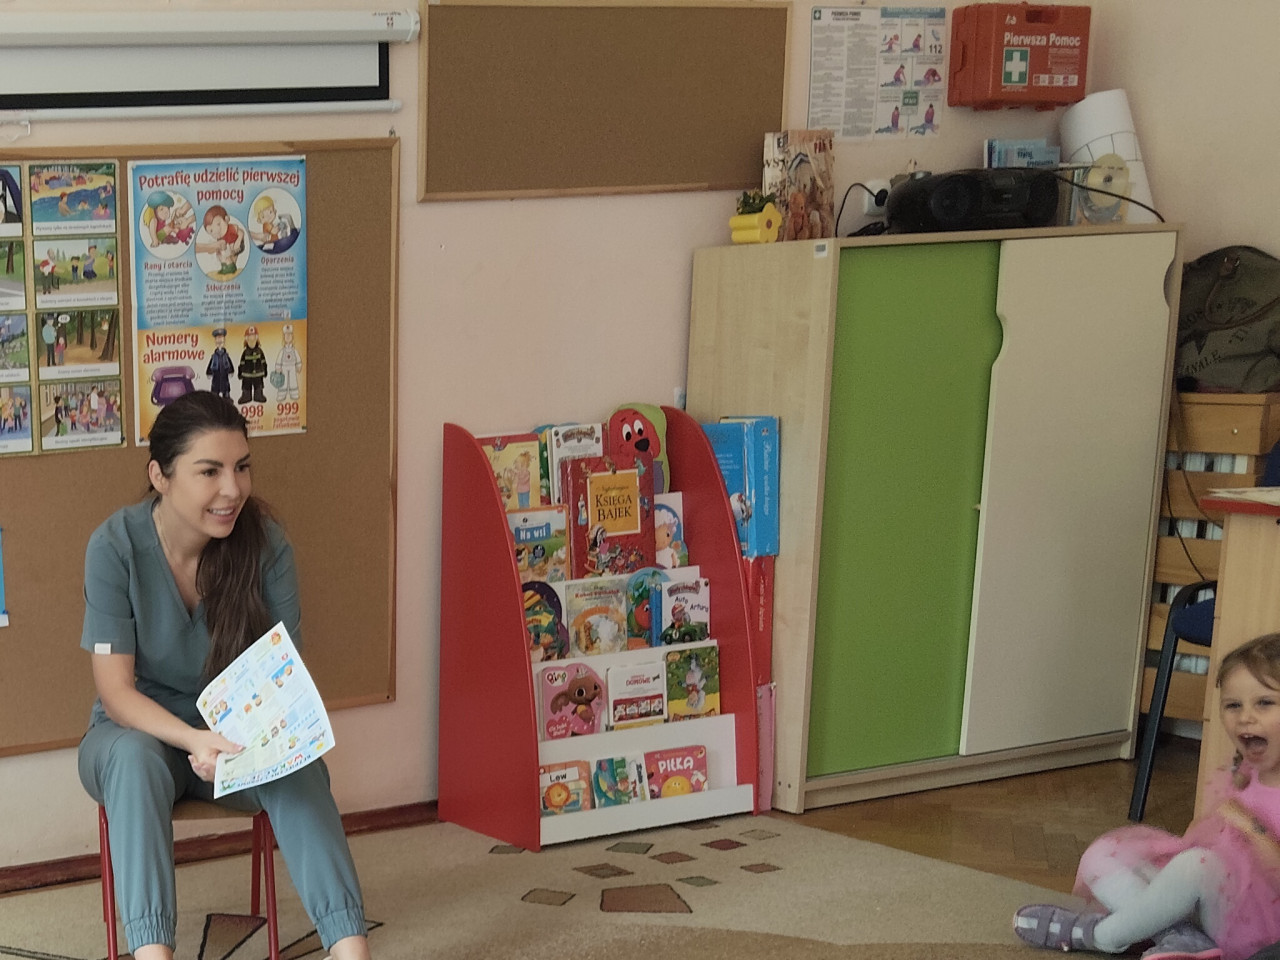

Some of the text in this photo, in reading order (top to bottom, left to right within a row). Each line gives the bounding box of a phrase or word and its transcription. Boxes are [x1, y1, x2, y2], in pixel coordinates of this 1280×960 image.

[1004, 32, 1081, 47] Pierwsza Pomoc
[929, 44, 943, 54] 112
[139, 167, 300, 190] Potrafię udzielić pierwszej
[197, 189, 244, 205] pomocy
[144, 262, 162, 271] Rany
[167, 261, 193, 270] otarcia
[260, 256, 294, 266] Oparzenia
[206, 284, 241, 292] Stłuczenia
[145, 332, 199, 348] Numery
[143, 349, 205, 364] alarmowe
[241, 402, 299, 419] 998 999
[595, 494, 632, 508] KSIĘGA
[597, 506, 632, 522] BAJEK
[675, 596, 688, 605] Auto
[547, 671, 567, 685] Bing
[658, 756, 694, 774] PIŁKA
